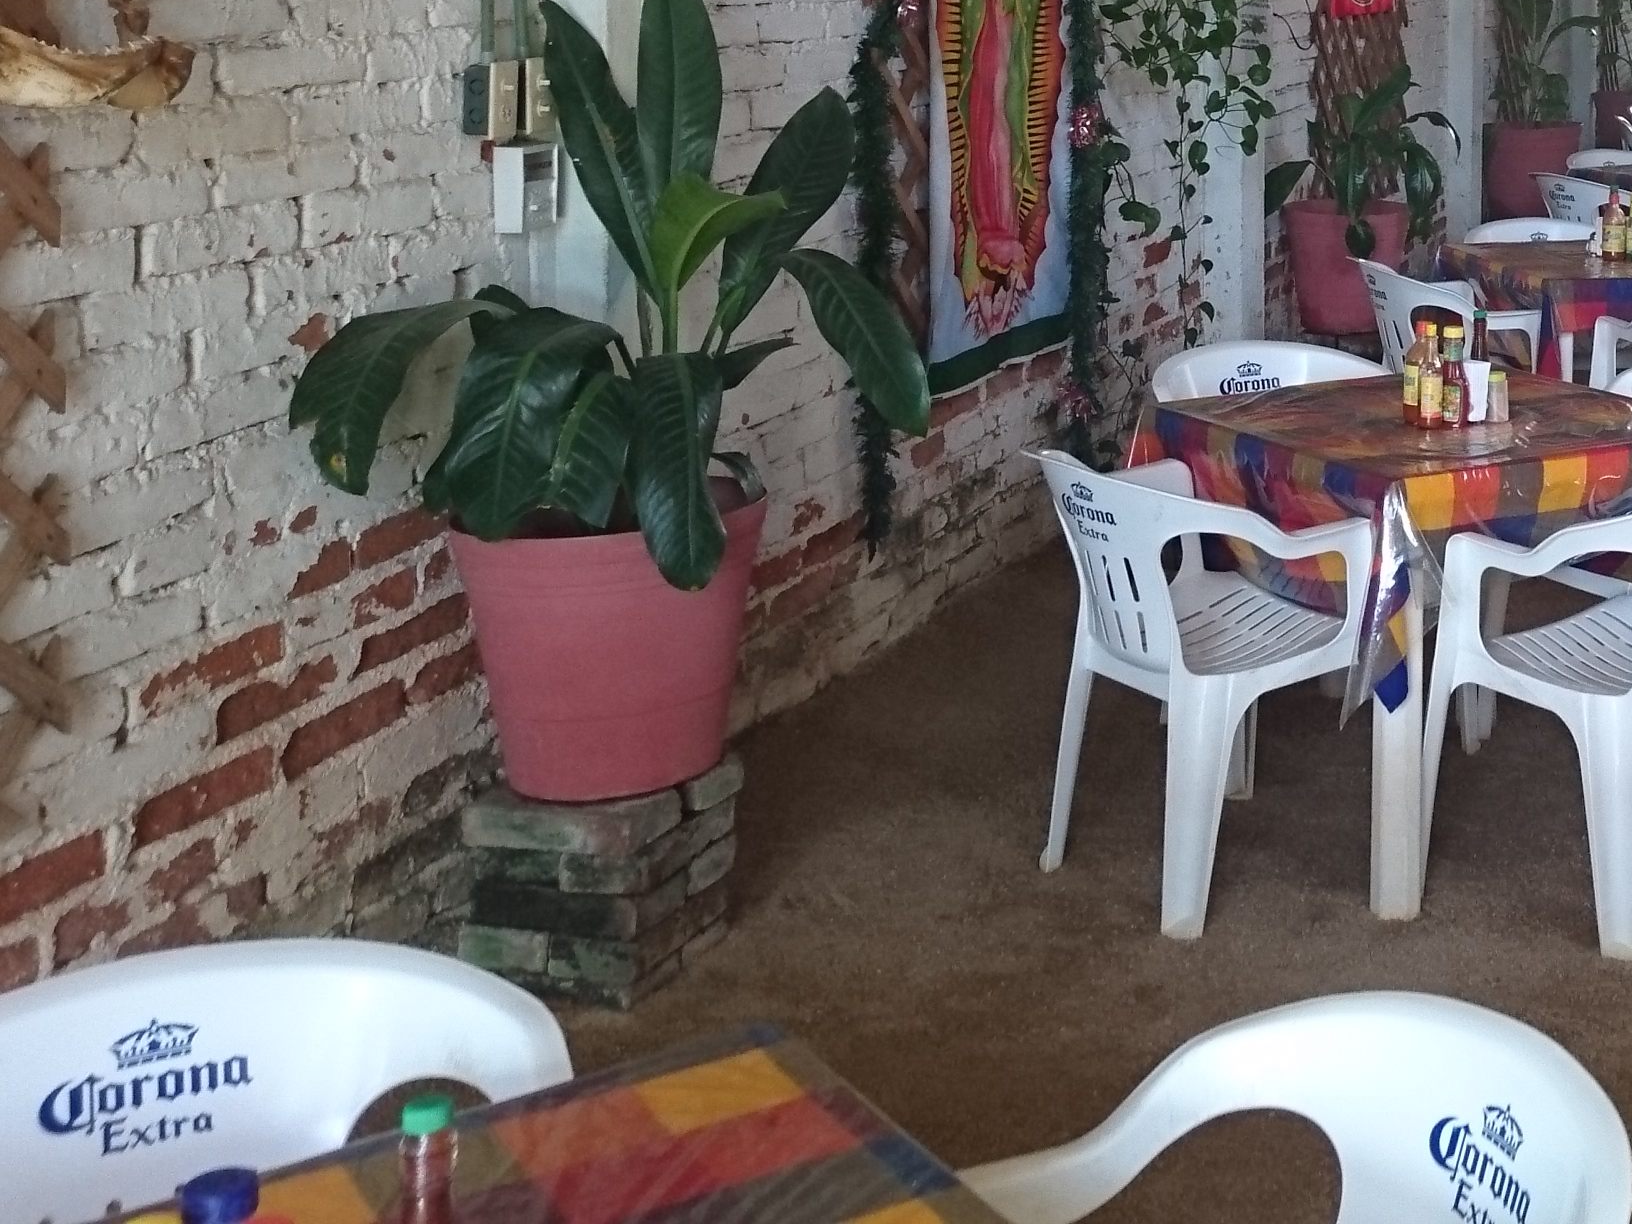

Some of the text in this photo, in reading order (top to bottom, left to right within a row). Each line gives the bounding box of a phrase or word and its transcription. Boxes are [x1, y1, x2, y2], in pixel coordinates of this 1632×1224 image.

[1219, 376, 1281, 396] Corona
[1061, 492, 1118, 527] Corona
[1076, 519, 1110, 543] Extra
[37, 1053, 254, 1137] Corona
[100, 1111, 215, 1157] Extra
[1428, 1115, 1532, 1224] Corona
